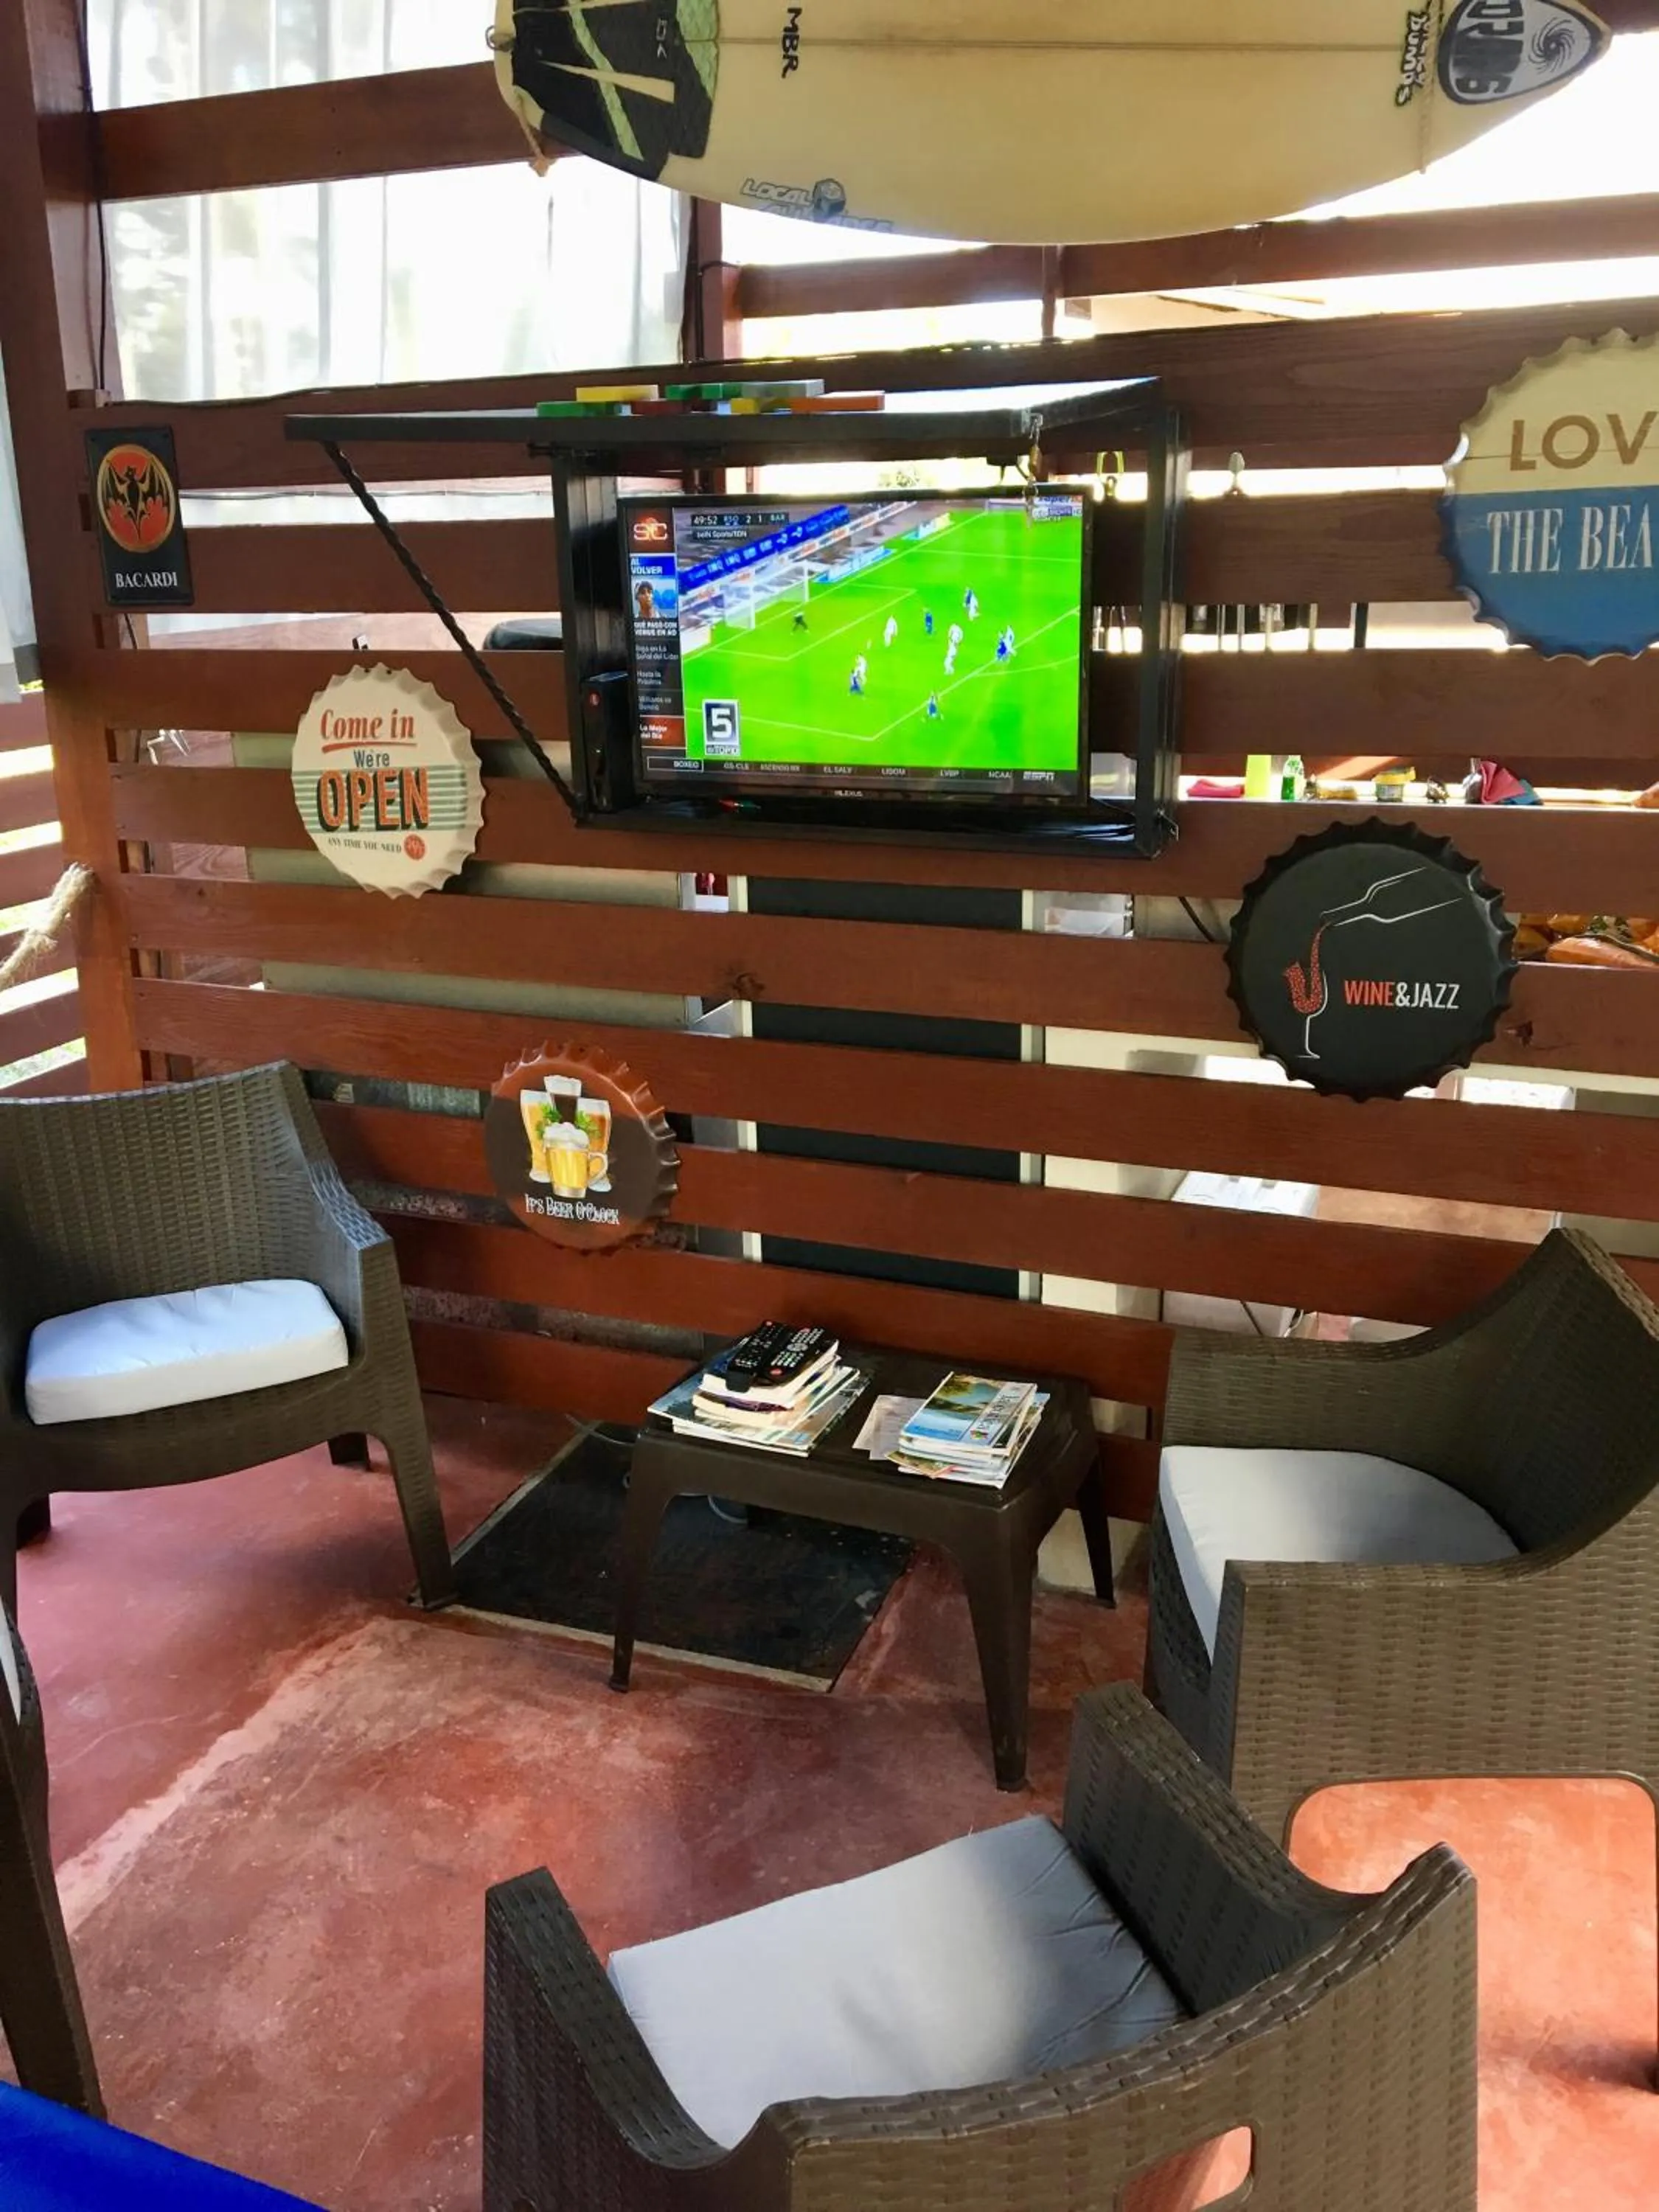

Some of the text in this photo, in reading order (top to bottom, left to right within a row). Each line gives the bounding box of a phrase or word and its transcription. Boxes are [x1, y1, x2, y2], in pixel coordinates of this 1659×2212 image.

[782, 7, 802, 78] MBR
[694, 515, 717, 524] 49:52
[1487, 503, 1654, 574] THE BEA
[115, 571, 178, 588] BACARDI
[631, 566, 663, 574] VOLVER
[320, 708, 415, 740] Come in
[711, 708, 733, 738] 5
[1023, 772, 1055, 781] ESPN
[317, 768, 430, 832] OPEN
[343, 838, 361, 849] TIME
[364, 840, 378, 850] YOU
[381, 843, 402, 853] NEED
[1344, 979, 1460, 1009] WINE&JAZZ
